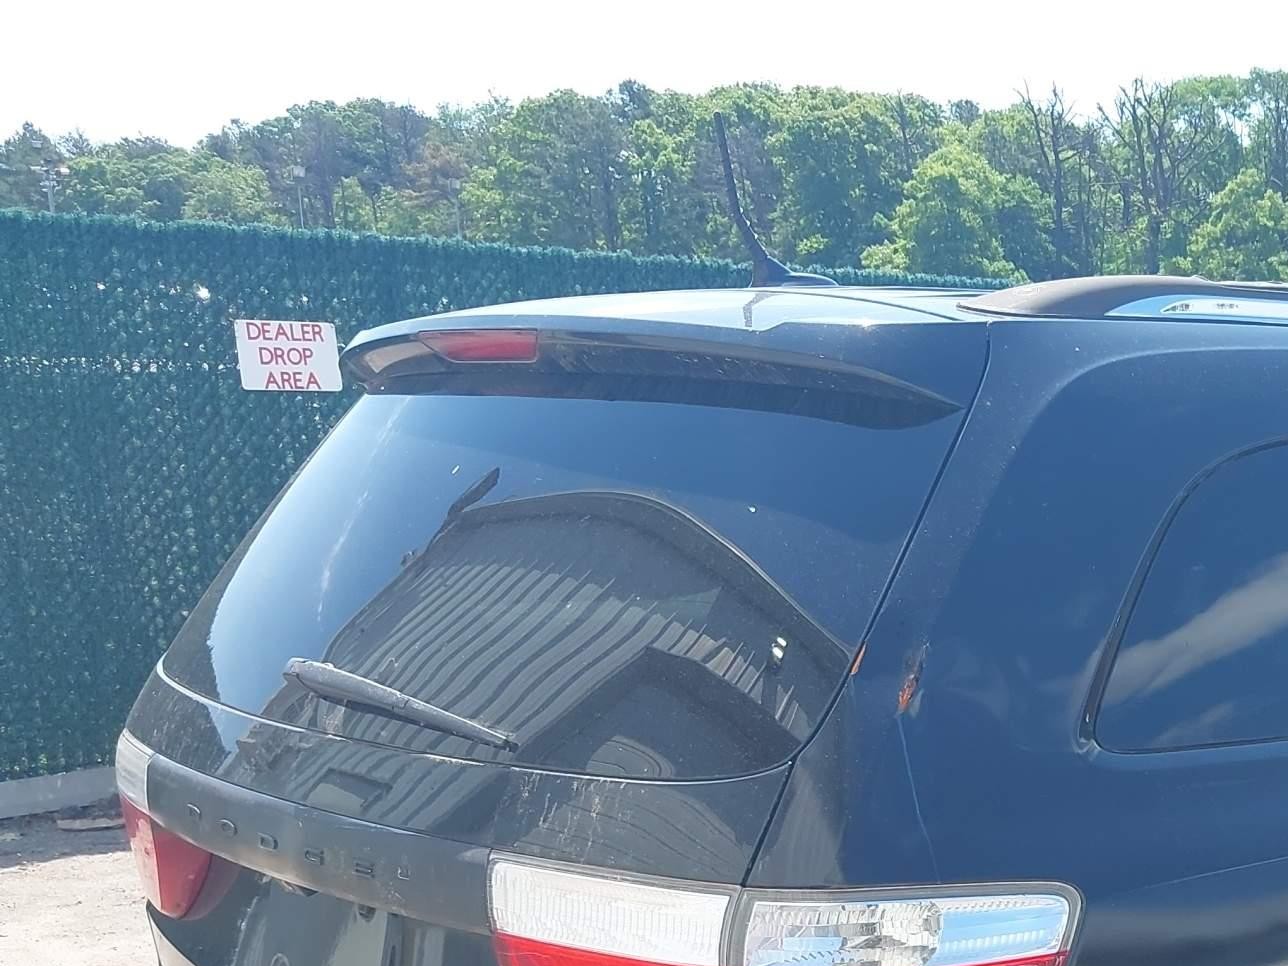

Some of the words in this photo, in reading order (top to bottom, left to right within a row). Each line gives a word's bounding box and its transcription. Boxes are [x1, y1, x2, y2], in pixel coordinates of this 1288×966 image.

[245, 322, 325, 342] DEALER
[258, 346, 314, 367] DROP
[265, 371, 322, 390] AREA
